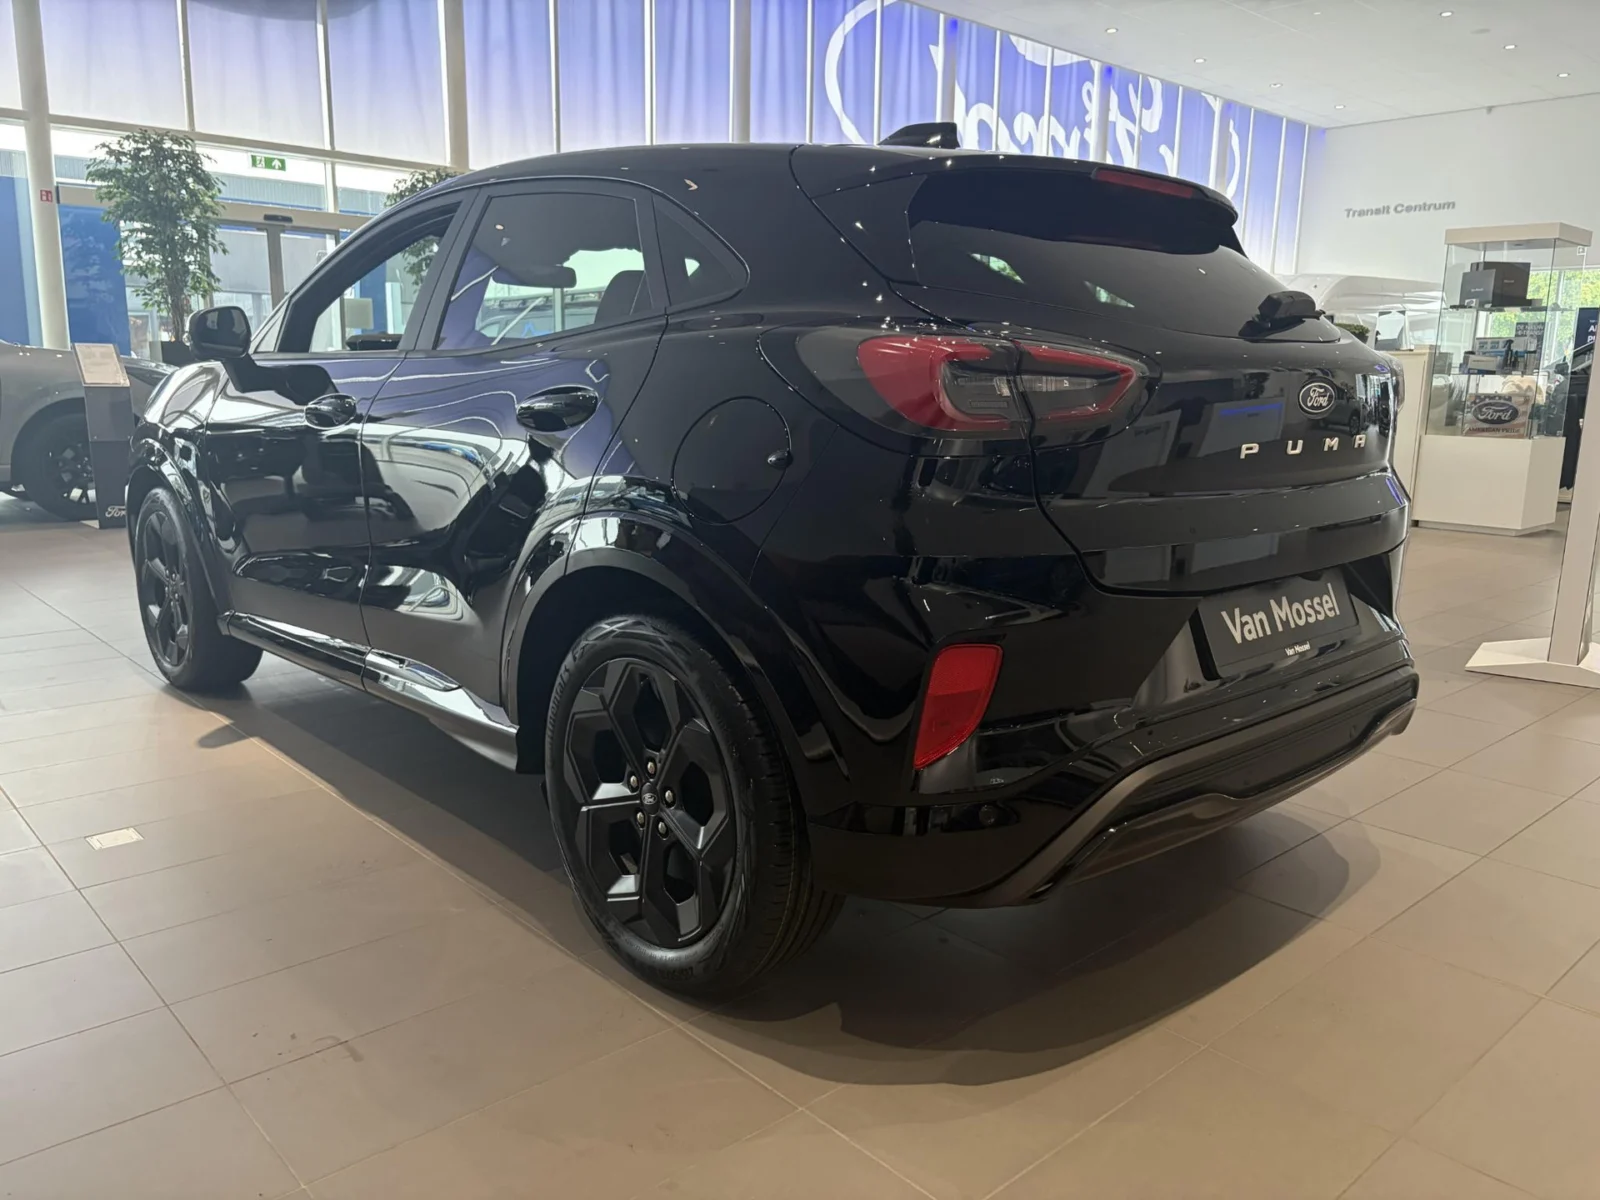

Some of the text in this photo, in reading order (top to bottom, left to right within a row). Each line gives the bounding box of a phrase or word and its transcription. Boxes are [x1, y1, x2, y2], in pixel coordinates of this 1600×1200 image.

[1344, 201, 1456, 219] Transit Centrum
[1307, 387, 1329, 407] Ford
[1478, 406, 1513, 420] Ford
[1240, 434, 1366, 459] PUMA
[105, 505, 127, 518] For
[1221, 582, 1340, 644] Van Mossel
[1284, 640, 1311, 657] Van Mossel
